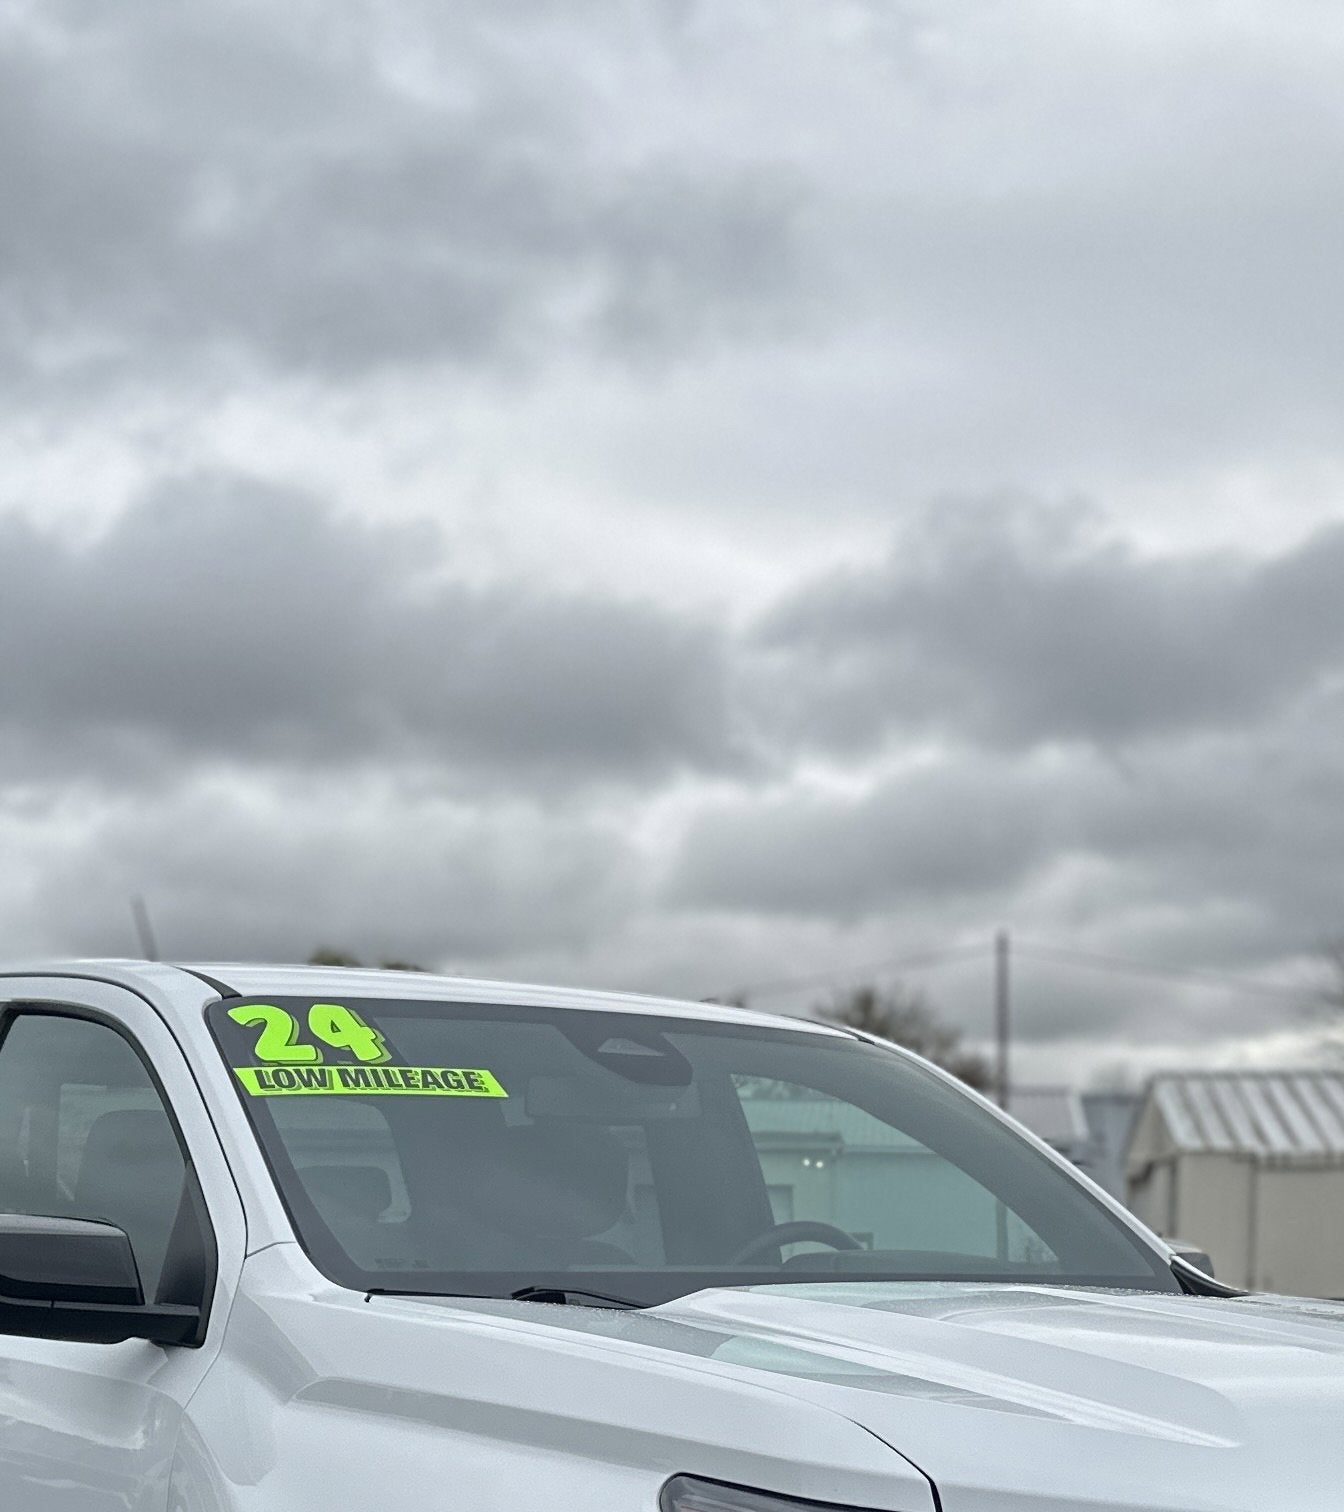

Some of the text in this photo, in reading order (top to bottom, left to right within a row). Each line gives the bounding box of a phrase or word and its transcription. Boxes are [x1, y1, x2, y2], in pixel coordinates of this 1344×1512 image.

[227, 1004, 391, 1066] 24
[254, 1067, 489, 1093] LOW MILEAGE
